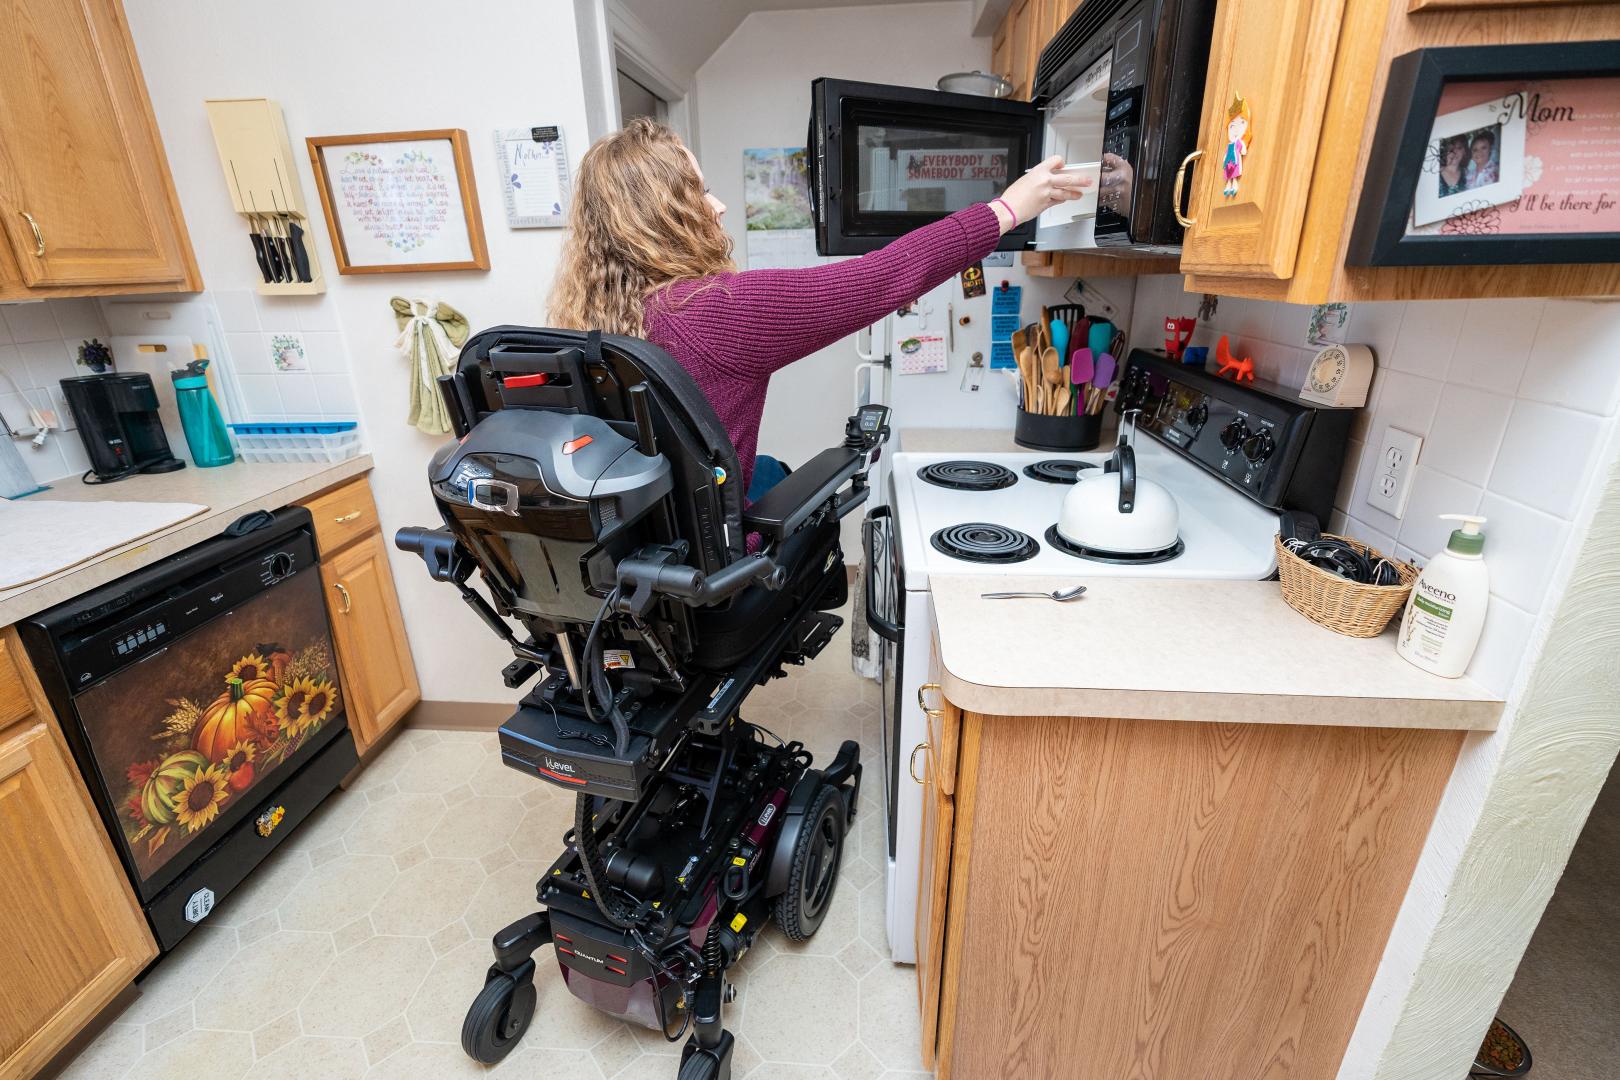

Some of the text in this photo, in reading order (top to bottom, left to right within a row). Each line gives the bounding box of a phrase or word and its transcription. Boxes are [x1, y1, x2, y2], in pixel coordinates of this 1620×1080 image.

[1497, 91, 1576, 125] Mom
[923, 154, 999, 166] EVERYBODY IS
[908, 167, 1008, 179] SOMEBODY SPECIA
[1509, 193, 1537, 213] I'll
[1540, 194, 1555, 211] be
[1559, 193, 1592, 211] there
[1592, 192, 1617, 215] for
[1419, 578, 1456, 601] Aveeno
[574, 949, 604, 964] QUANTUM
